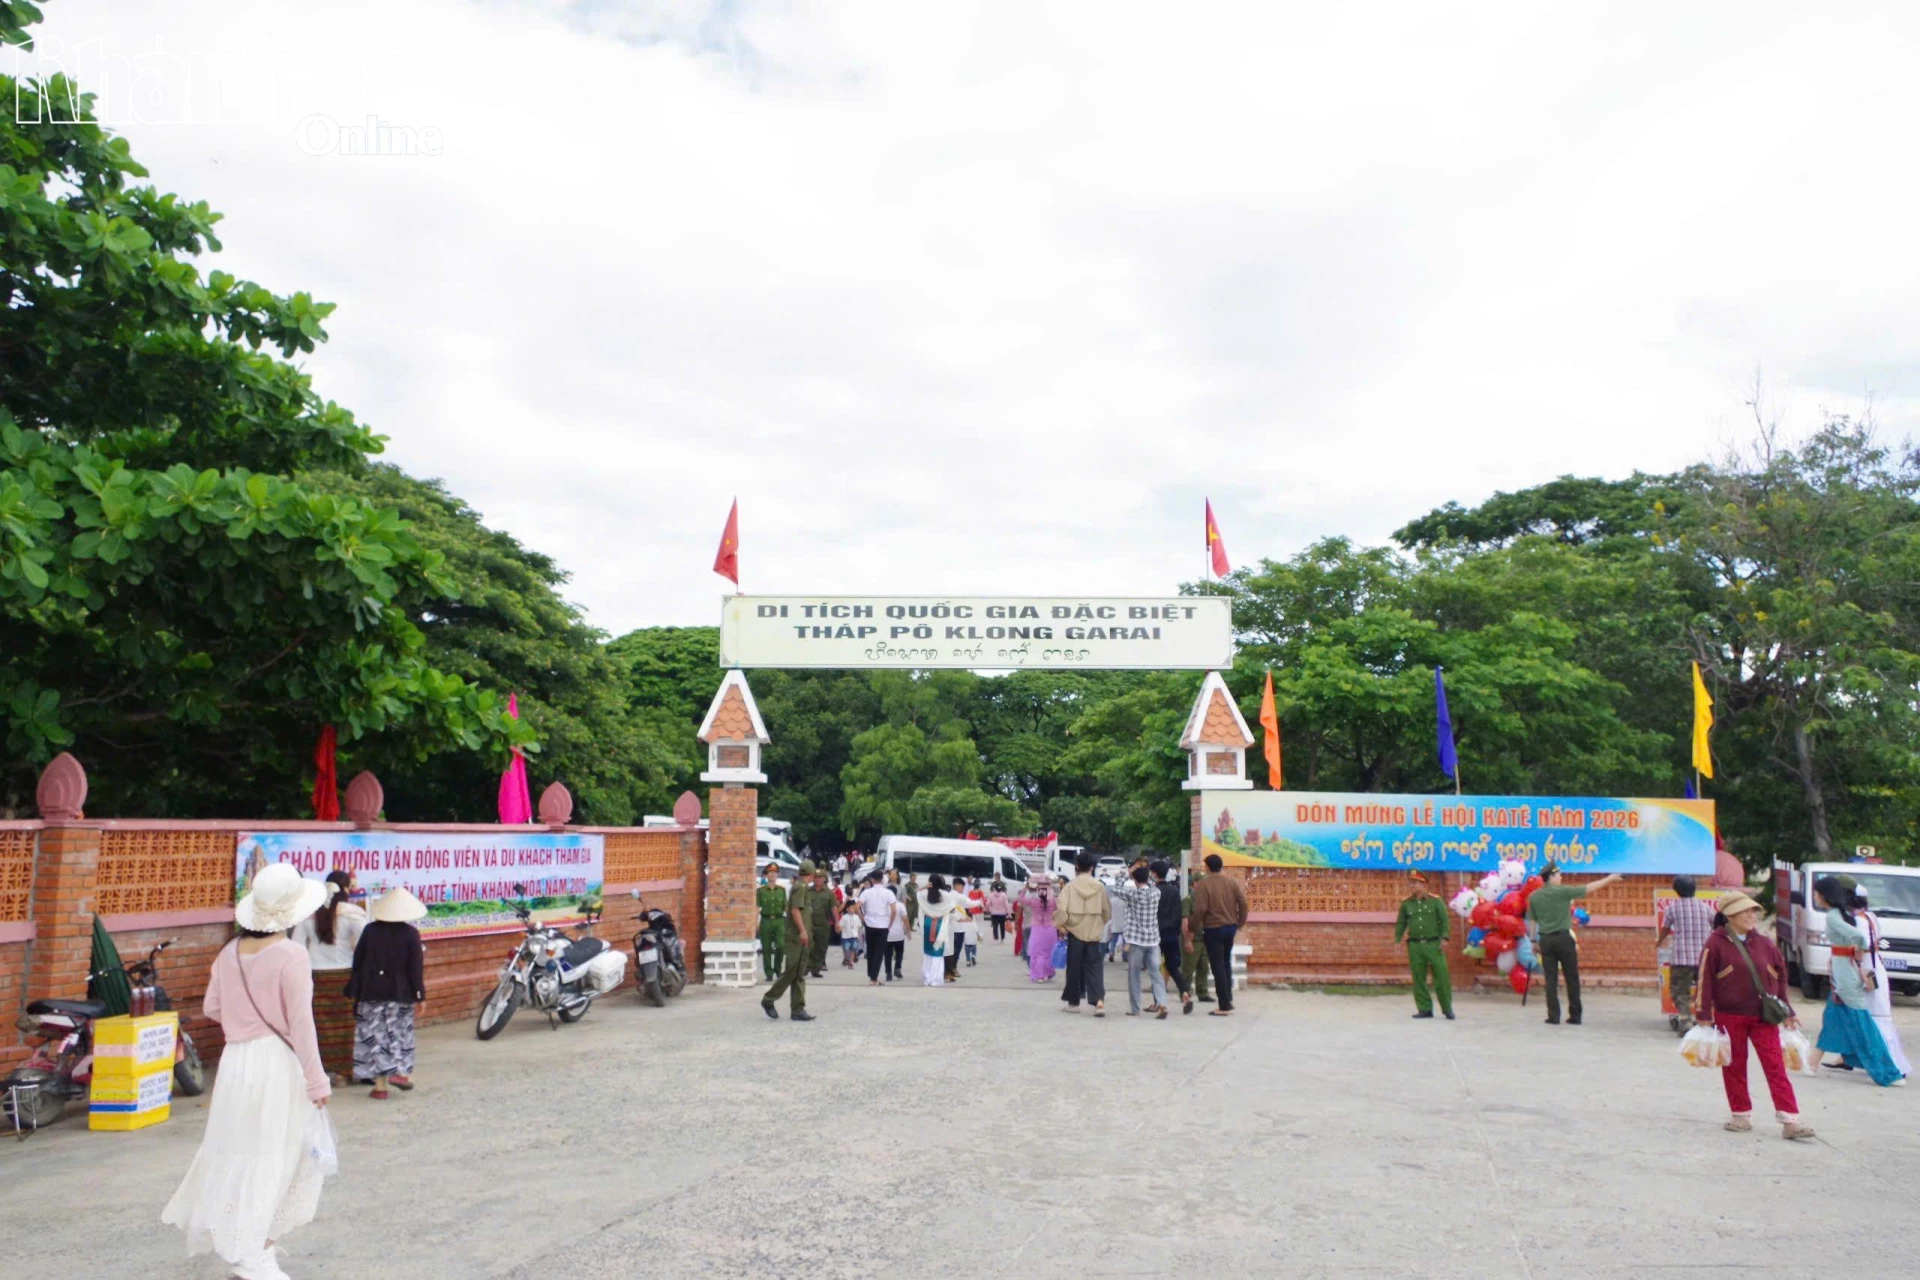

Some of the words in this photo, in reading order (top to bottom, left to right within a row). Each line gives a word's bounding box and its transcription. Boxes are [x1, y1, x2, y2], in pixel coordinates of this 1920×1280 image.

[758, 605, 788, 618] DI
[801, 602, 873, 618] TÍCH
[886, 601, 973, 619] QUỐC
[986, 605, 1039, 619] GIA
[1051, 603, 1116, 622] ĐẶC
[1129, 604, 1198, 622] BIỆT
[793, 623, 877, 639] THÁP
[890, 624, 933, 639] PÔ
[946, 626, 1053, 640] KLONG
[1065, 626, 1161, 640] GARAI
[1441, 803, 1477, 831] HỘI
[1483, 804, 1532, 828] KATÊ
[1538, 804, 1585, 829] NĂM
[1591, 810, 1640, 829] 2026
[279, 846, 325, 872] CHÀO
[384, 845, 411, 875] VẬN
[415, 845, 450, 874] ĐỘNG
[454, 845, 480, 868] VIÊN
[484, 845, 498, 867] VÀ
[501, 849, 514, 867] DU
[555, 847, 580, 865] THAM
